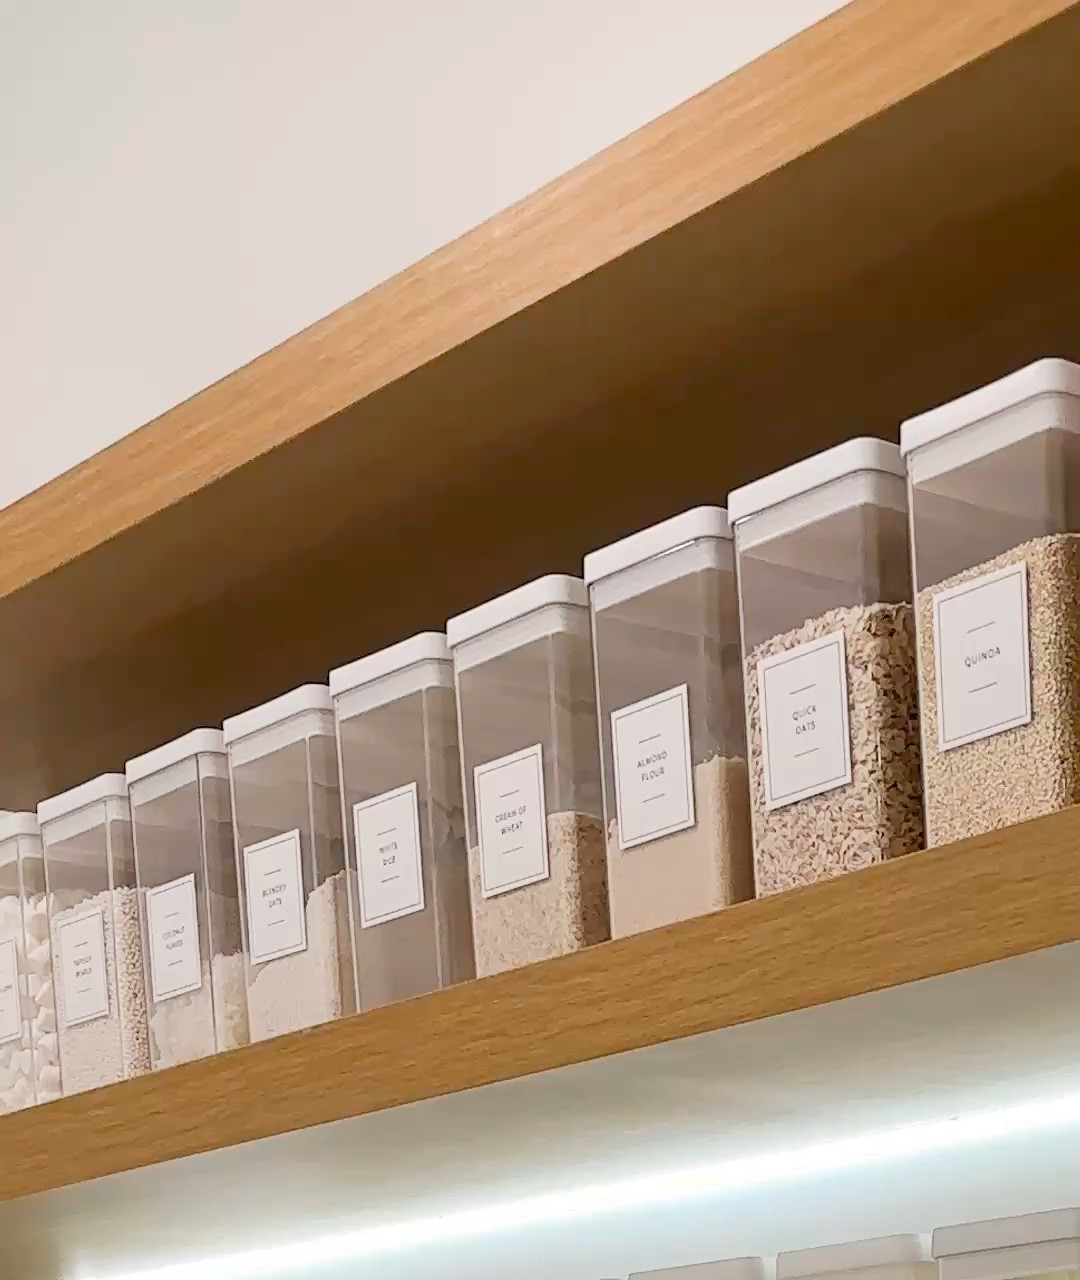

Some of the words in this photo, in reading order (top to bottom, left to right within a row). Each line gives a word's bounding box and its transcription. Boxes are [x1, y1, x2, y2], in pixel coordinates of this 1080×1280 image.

[964, 646, 1001, 669] QUINOA
[791, 704, 817, 723] QUICK
[793, 718, 816, 736] OATS
[636, 750, 668, 771] ALMOND
[639, 765, 665, 783] FLOUR
